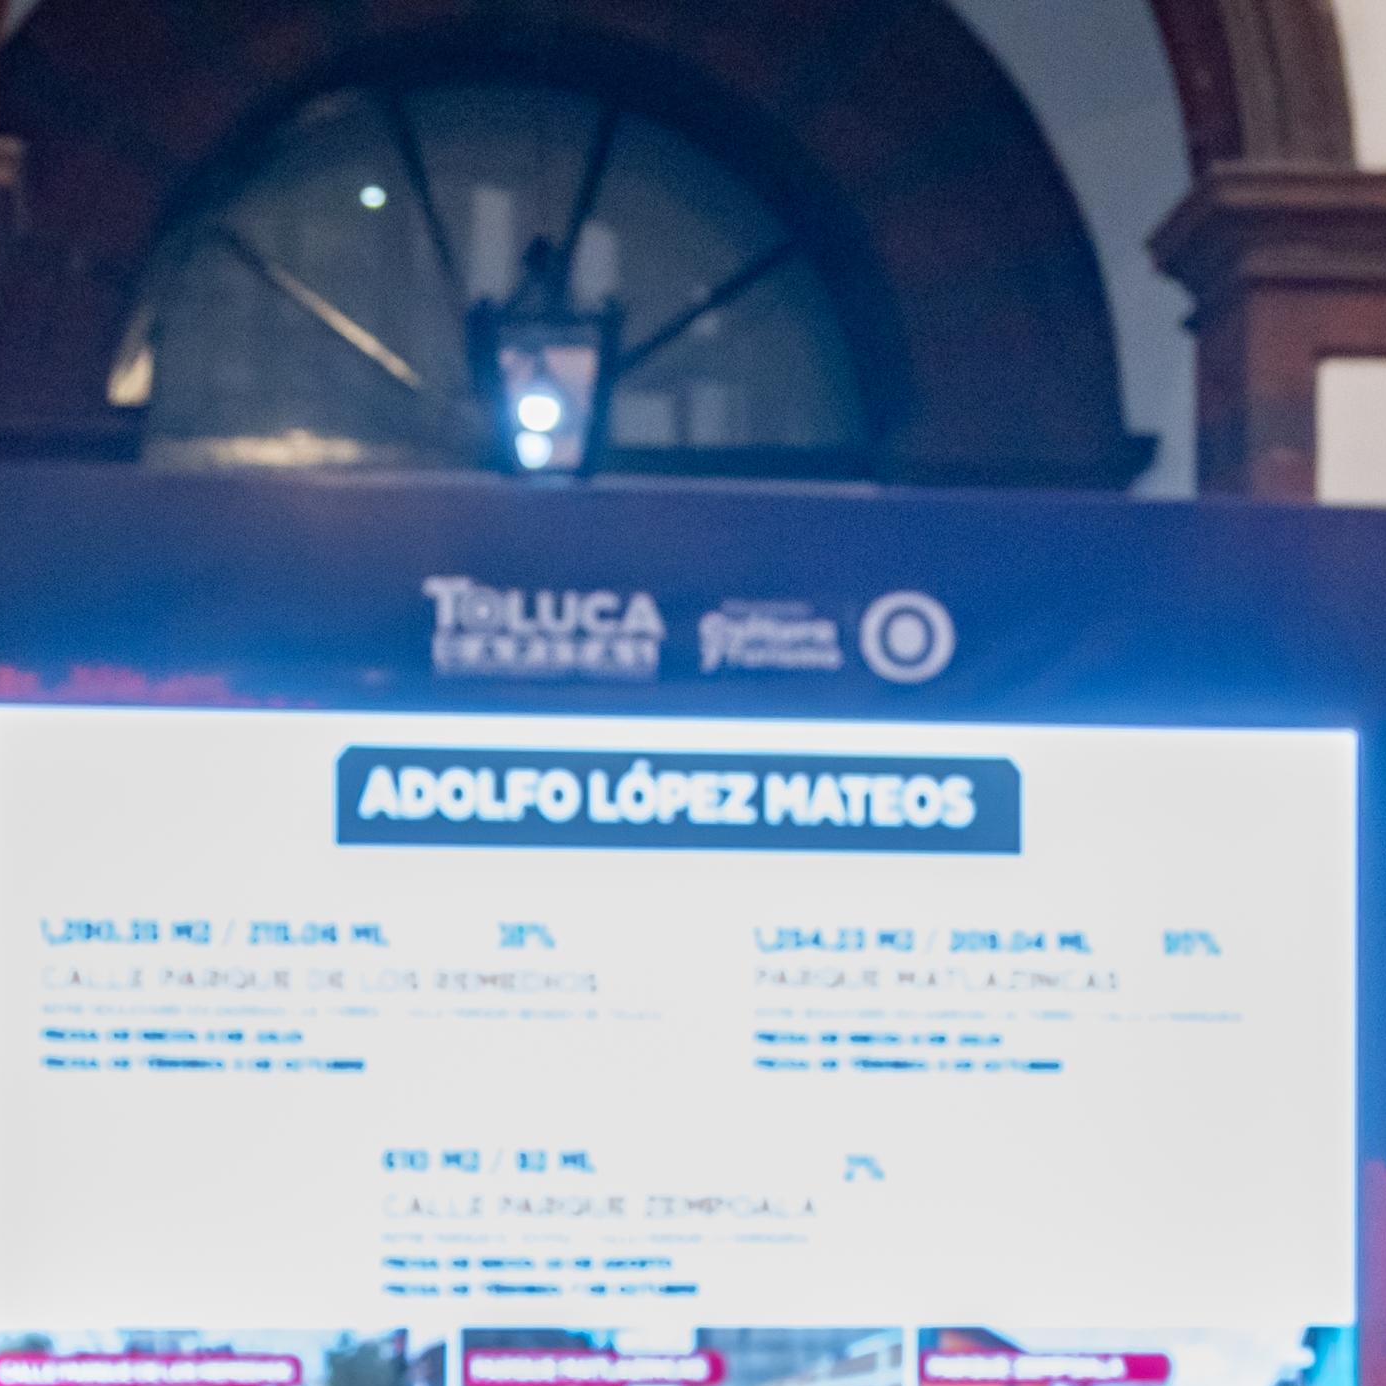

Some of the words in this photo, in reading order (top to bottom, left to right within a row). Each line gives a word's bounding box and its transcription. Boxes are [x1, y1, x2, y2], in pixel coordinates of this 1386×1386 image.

[358, 763, 582, 823] ADOLFO
[587, 757, 757, 826] LÓPEZ
[763, 771, 977, 830] MATEOS
